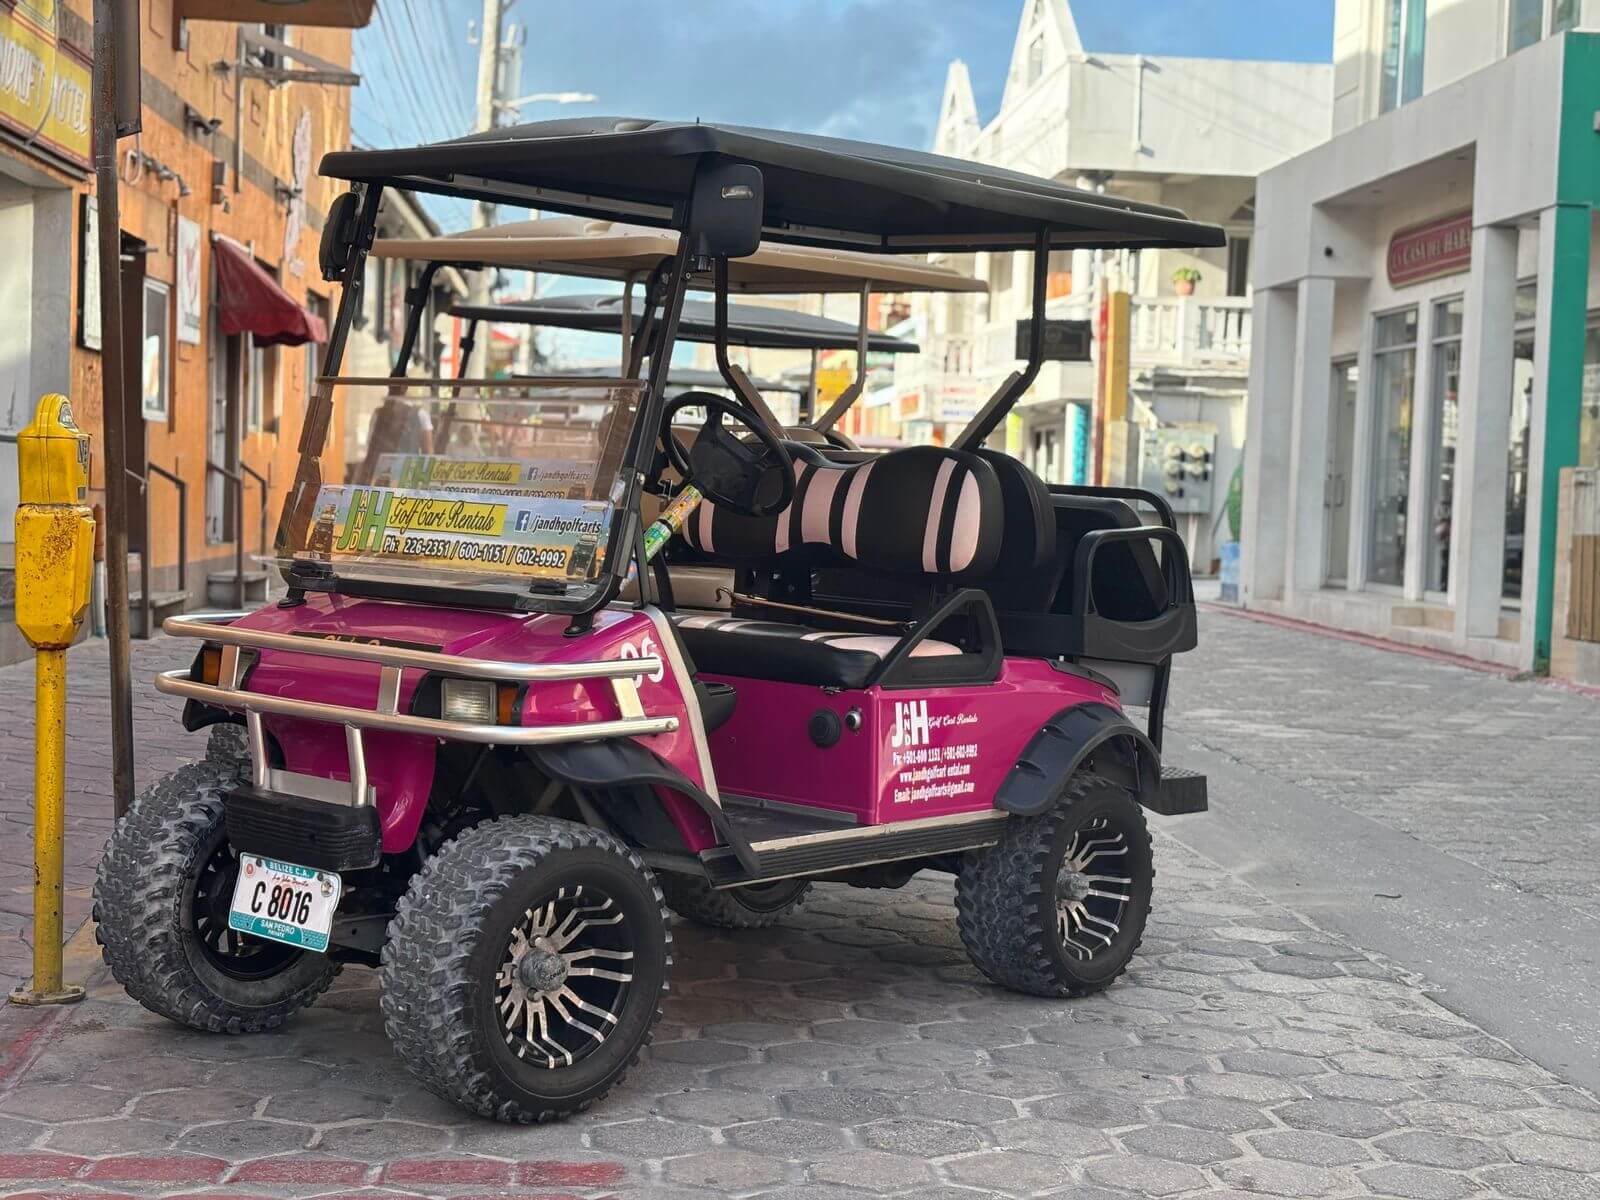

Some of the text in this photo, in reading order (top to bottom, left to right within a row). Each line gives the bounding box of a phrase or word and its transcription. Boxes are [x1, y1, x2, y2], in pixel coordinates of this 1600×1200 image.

[390, 495, 420, 534] Golf
[418, 499, 446, 526] Cart
[445, 500, 495, 532] Rentals
[383, 535, 400, 554] Ph:
[403, 537, 451, 558] 226-2351
[458, 542, 507, 563] 600-1151
[515, 547, 567, 568] 602-9992
[269, 861, 295, 874] BELIZE
[252, 881, 266, 913] C
[267, 885, 312, 924] 8016
[260, 919, 274, 929] SAN
[273, 922, 296, 935] PEDRO
